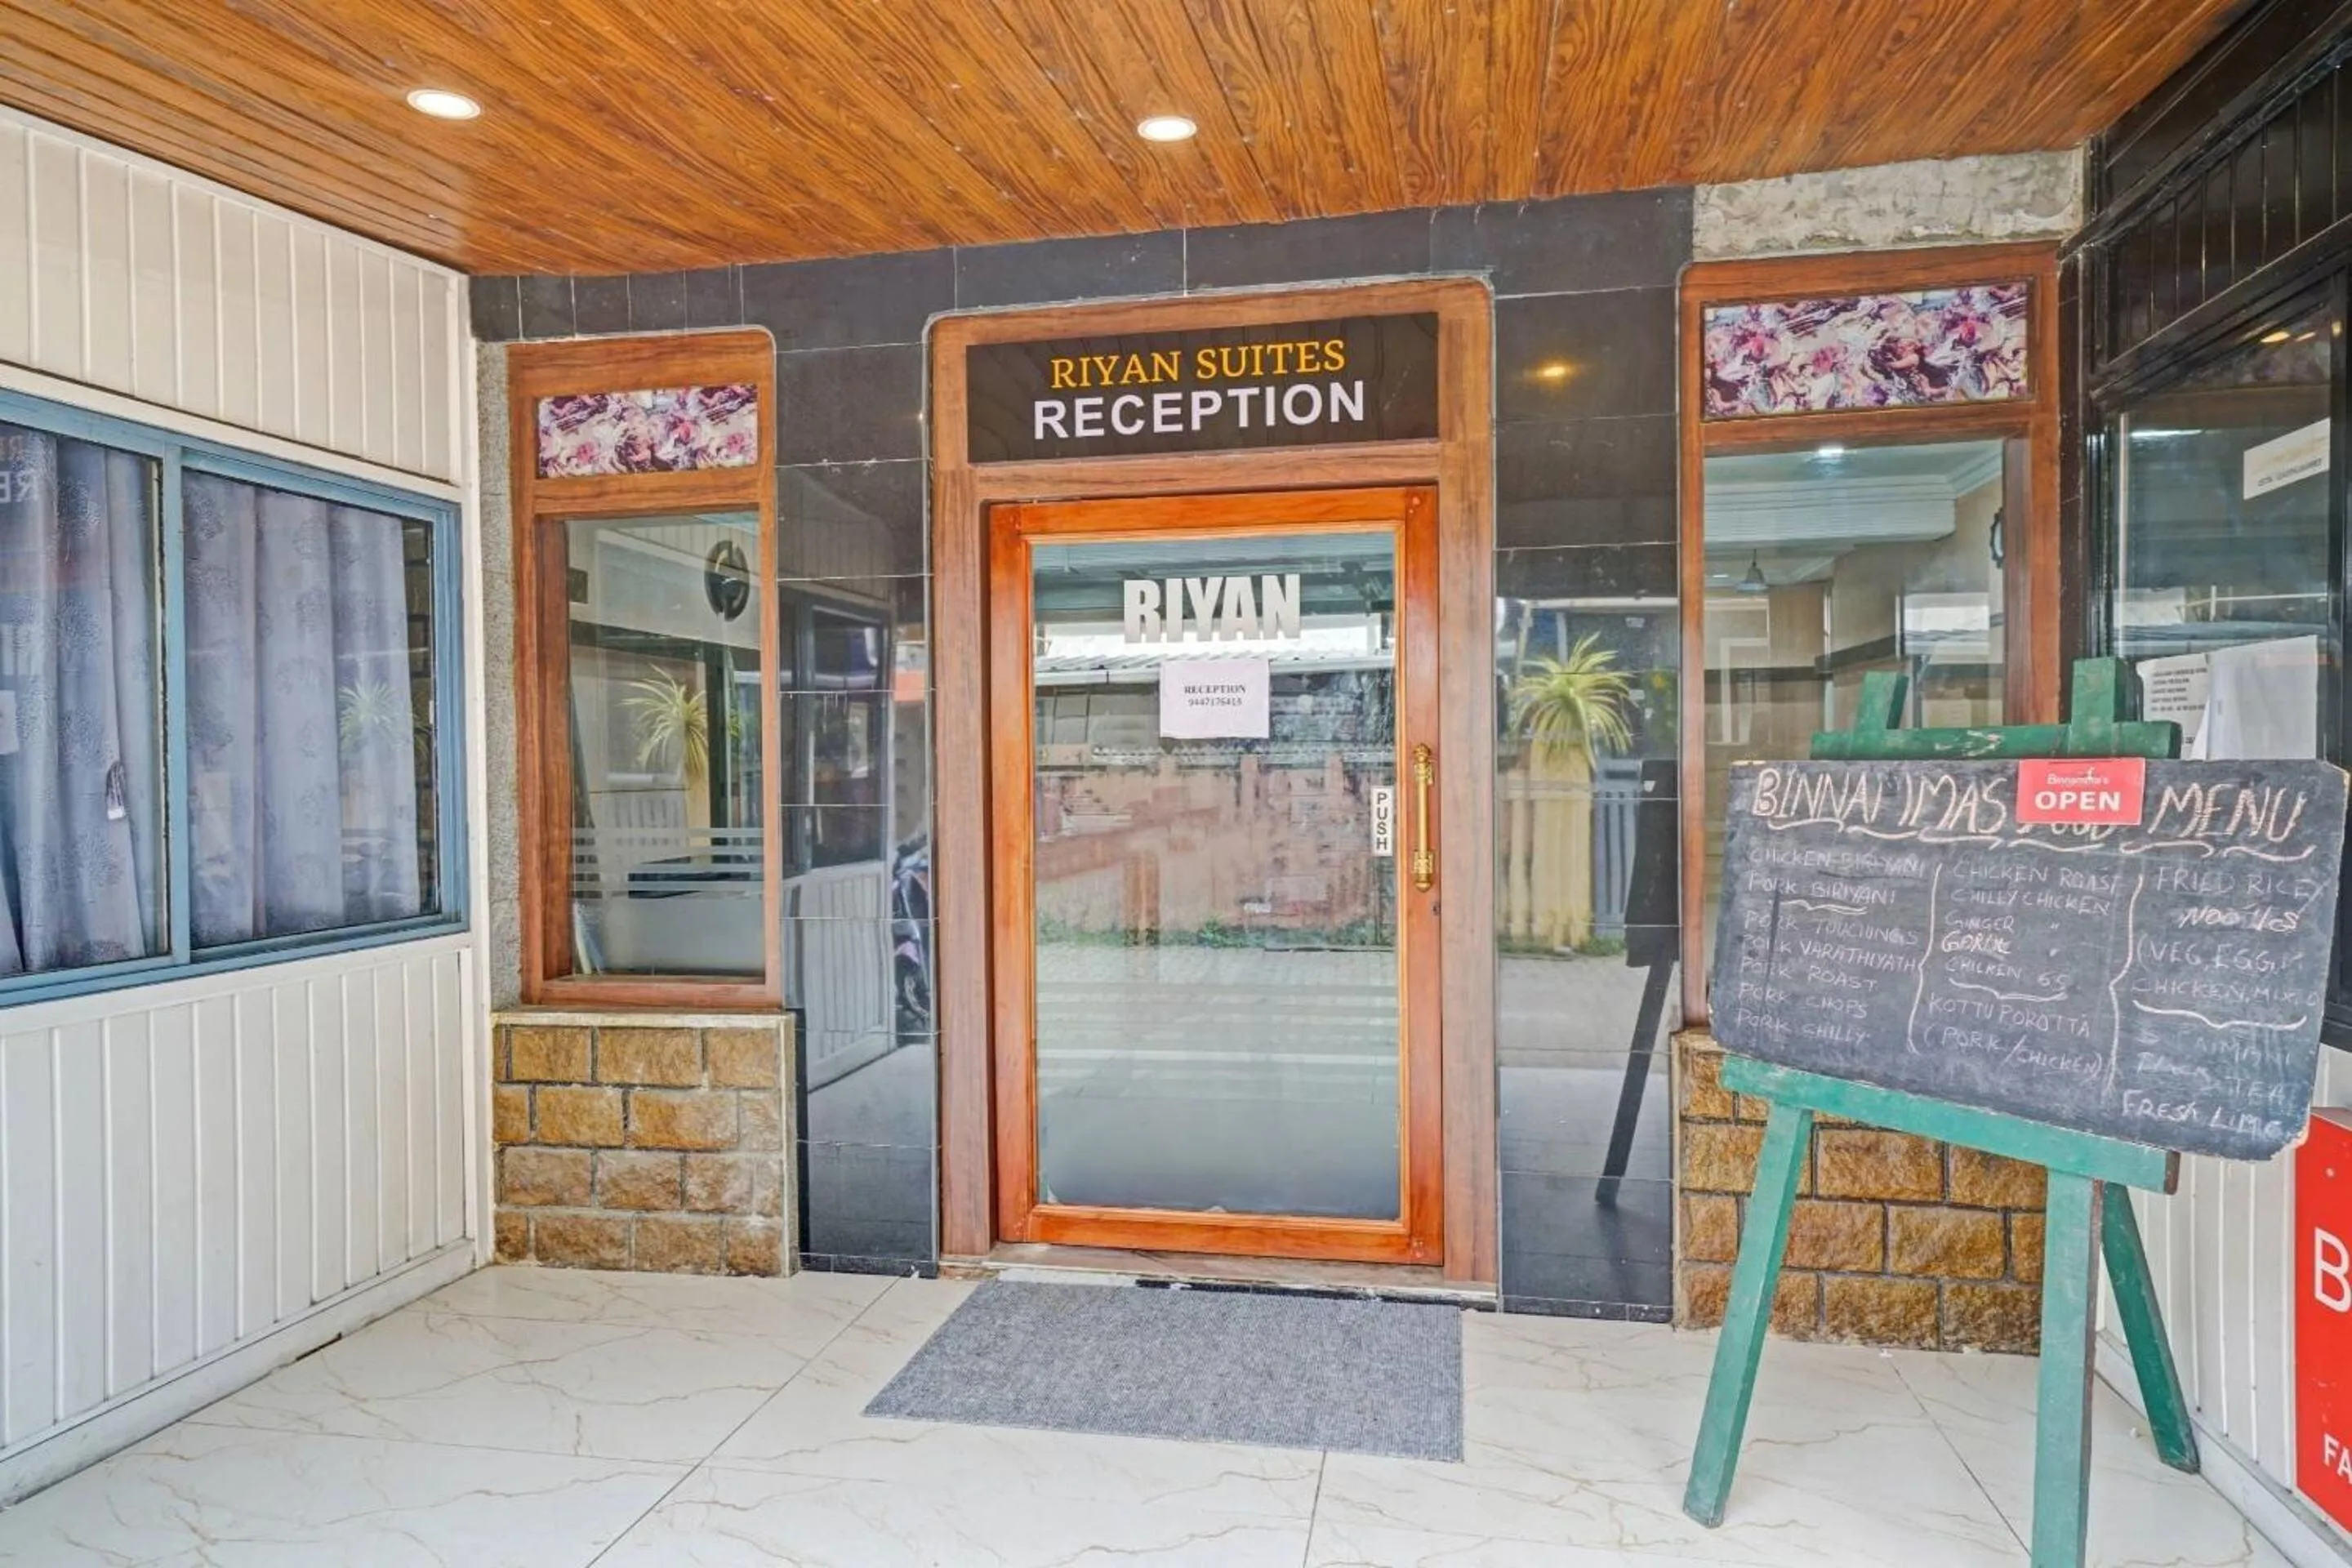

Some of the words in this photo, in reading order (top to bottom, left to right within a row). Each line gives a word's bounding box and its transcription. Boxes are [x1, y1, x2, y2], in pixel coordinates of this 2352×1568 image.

[1050, 350, 1181, 390] RIYAN
[1196, 339, 1346, 380] SUITES
[1034, 381, 1365, 440] RECEPTION
[1123, 573, 1301, 644] RIYAN
[1184, 684, 1246, 694] RECEPTION
[1376, 792, 1388, 850] PUSH
[2034, 791, 2121, 811] OPEN
[2146, 782, 2308, 843] MENU
[2156, 866, 2236, 893] FRIED
[1807, 964, 1878, 992] ROAST
